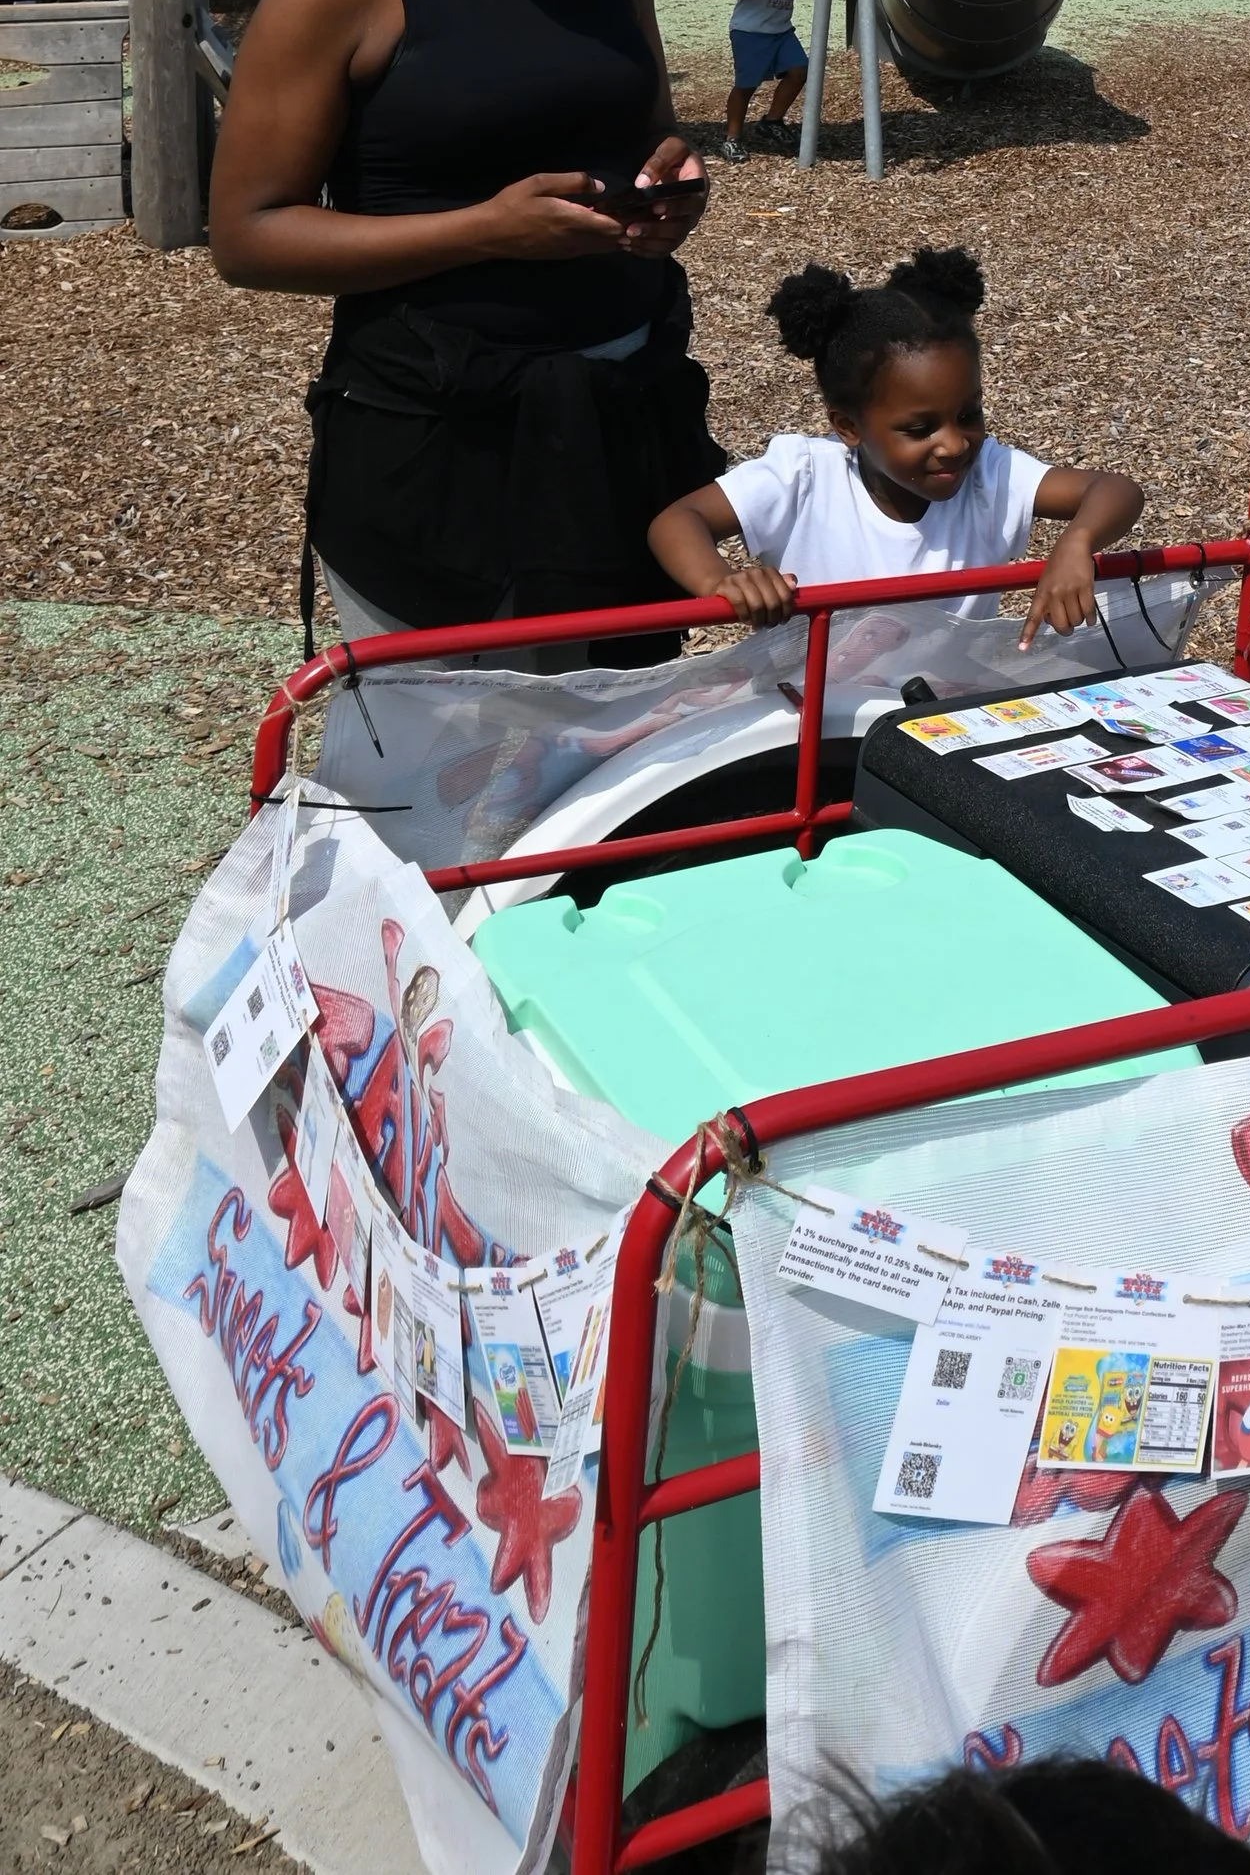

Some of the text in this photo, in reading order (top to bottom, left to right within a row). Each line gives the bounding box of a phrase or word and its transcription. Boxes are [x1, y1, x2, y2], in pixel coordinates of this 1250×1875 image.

[789, 1238, 920, 1288] is automatically added to all card
[794, 1226, 802, 1235] A
[803, 1228, 816, 1240] 3%
[817, 1234, 859, 1254] surcharge
[859, 1246, 876, 1259] and
[876, 1253, 882, 1261] a
[883, 1254, 911, 1271] 10.25%
[912, 1264, 935, 1278] Sales
[936, 1271, 950, 1284] Tax
[778, 1264, 815, 1283] provider.
[784, 1251, 911, 1299] transactions by the card service
[954, 1287, 968, 1297] Tax
[970, 1289, 1006, 1303] included
[1007, 1294, 1016, 1303] in
[1017, 1296, 1039, 1307] Cash,
[941, 1299, 1046, 1322] hApp, and Paypal Pricing:
[1221, 1323, 1247, 1331] Spider-Man
[1153, 1361, 1210, 1373] Nutrition Facts
[1149, 1392, 1168, 1400] Calories
[1175, 1391, 1188, 1401] 160
